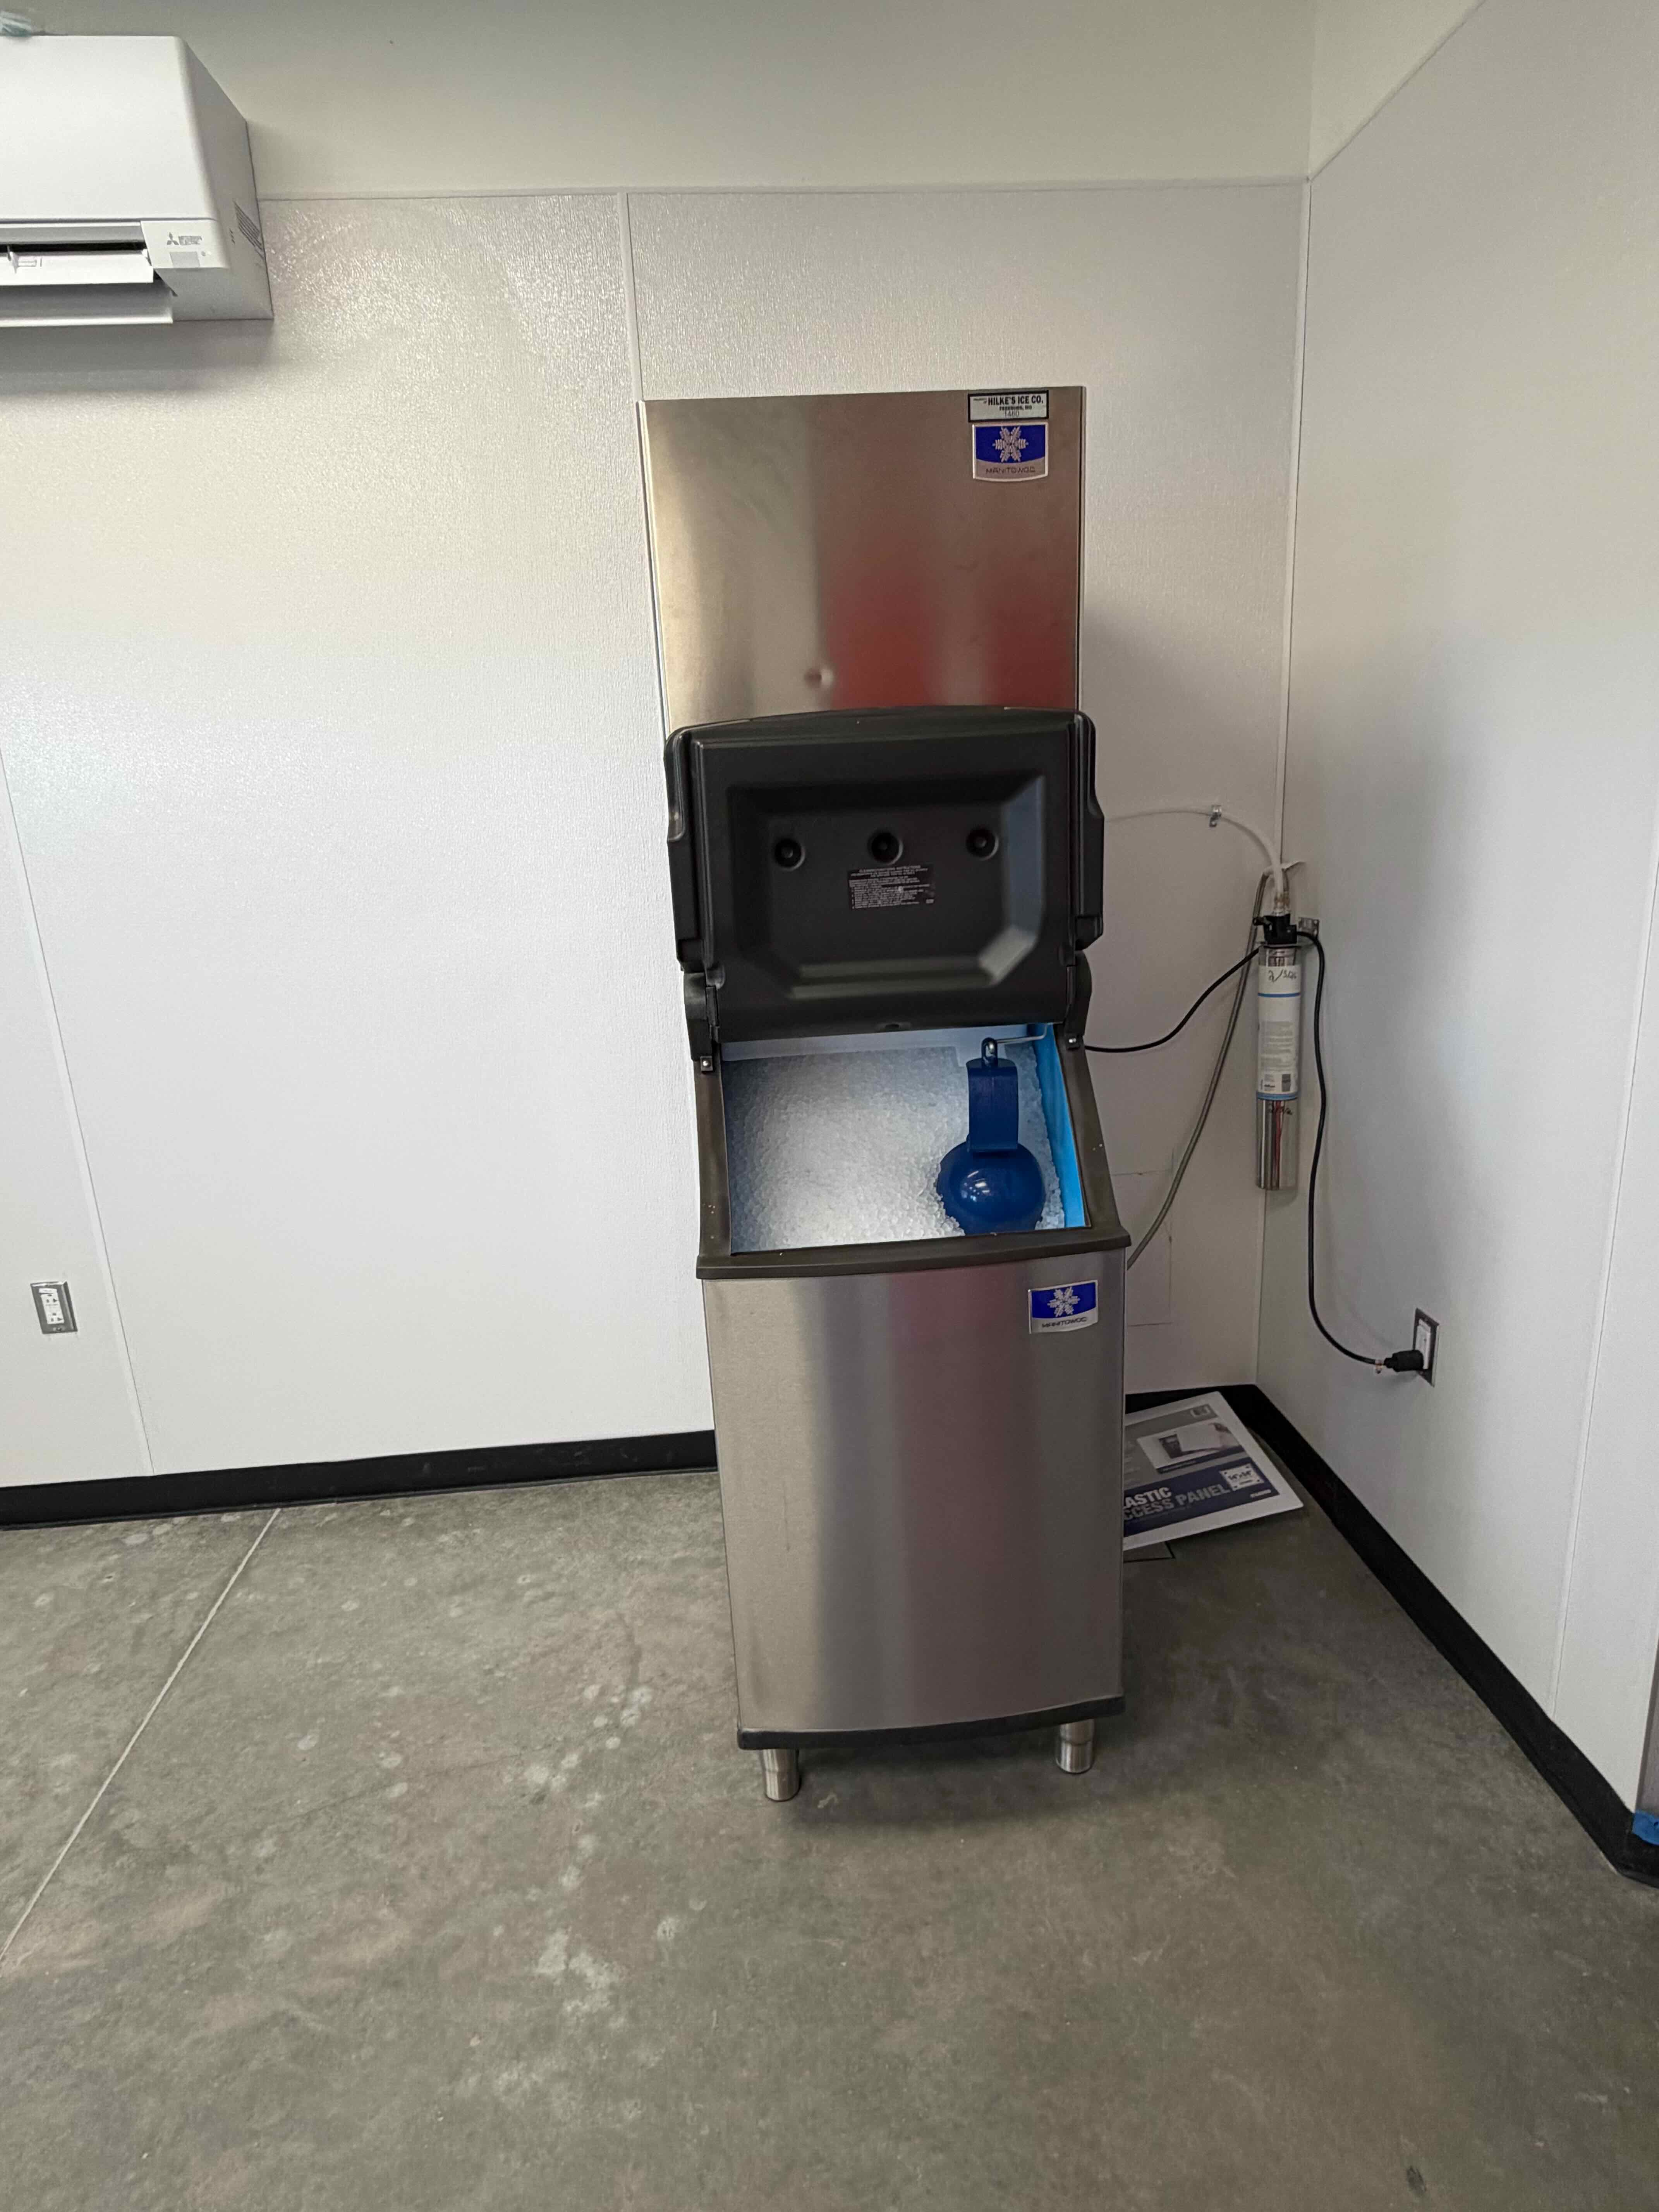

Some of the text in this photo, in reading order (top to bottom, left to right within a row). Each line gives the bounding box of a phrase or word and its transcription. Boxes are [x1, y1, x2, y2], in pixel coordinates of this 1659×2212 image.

[988, 397, 1015, 405] HILKE'S
[1018, 396, 1029, 404] ICE
[1031, 395, 1043, 404] CO.
[986, 466, 1036, 474] MANITOWOC
[1041, 1317, 1087, 1328] MANITOWOC
[1123, 1487, 1171, 1509] ASTIC
[1123, 1498, 1175, 1520] CCESS
[1175, 1484, 1230, 1506] PANEL
